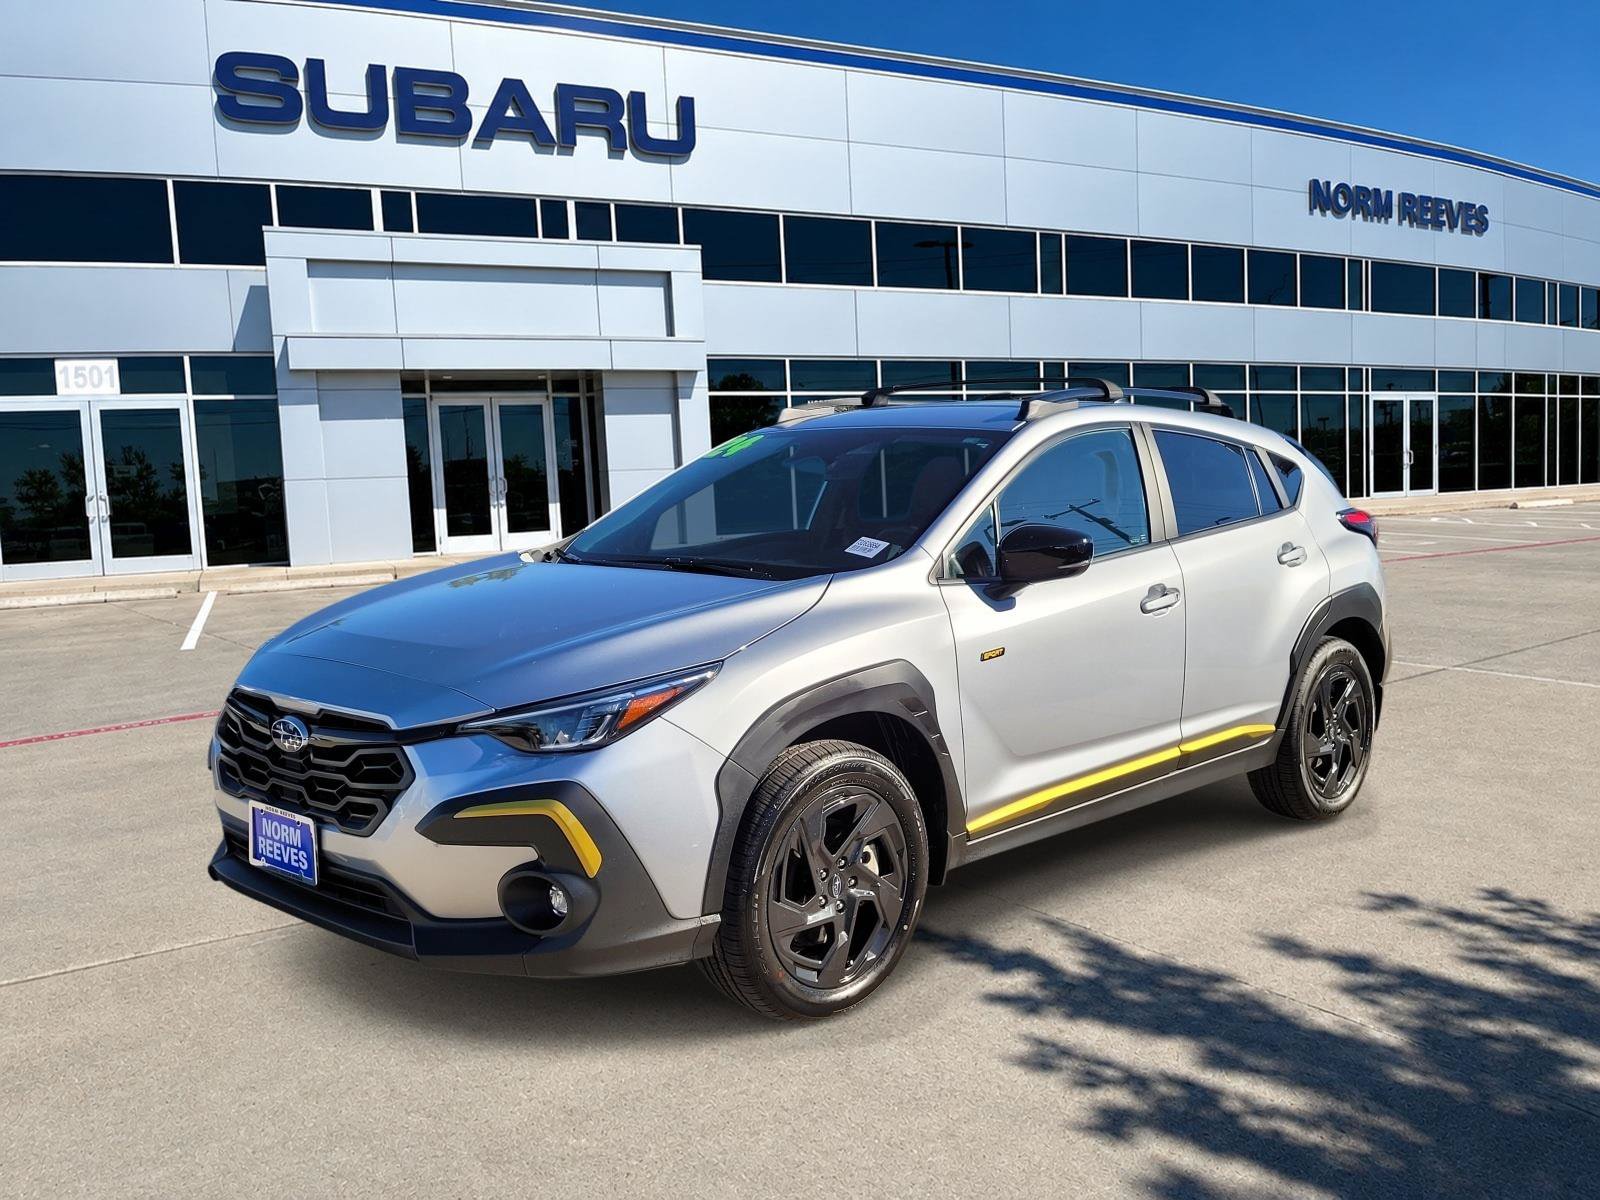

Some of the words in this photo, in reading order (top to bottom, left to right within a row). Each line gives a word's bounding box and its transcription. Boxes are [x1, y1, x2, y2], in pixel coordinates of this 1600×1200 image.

[213, 51, 696, 157] SUBARU
[1309, 178, 1393, 220] NORM
[1398, 191, 1490, 234] REEVES
[59, 364, 115, 389] 1501
[982, 648, 1004, 660] SPORT
[262, 817, 302, 848] NORM
[258, 836, 308, 870] REEVES
